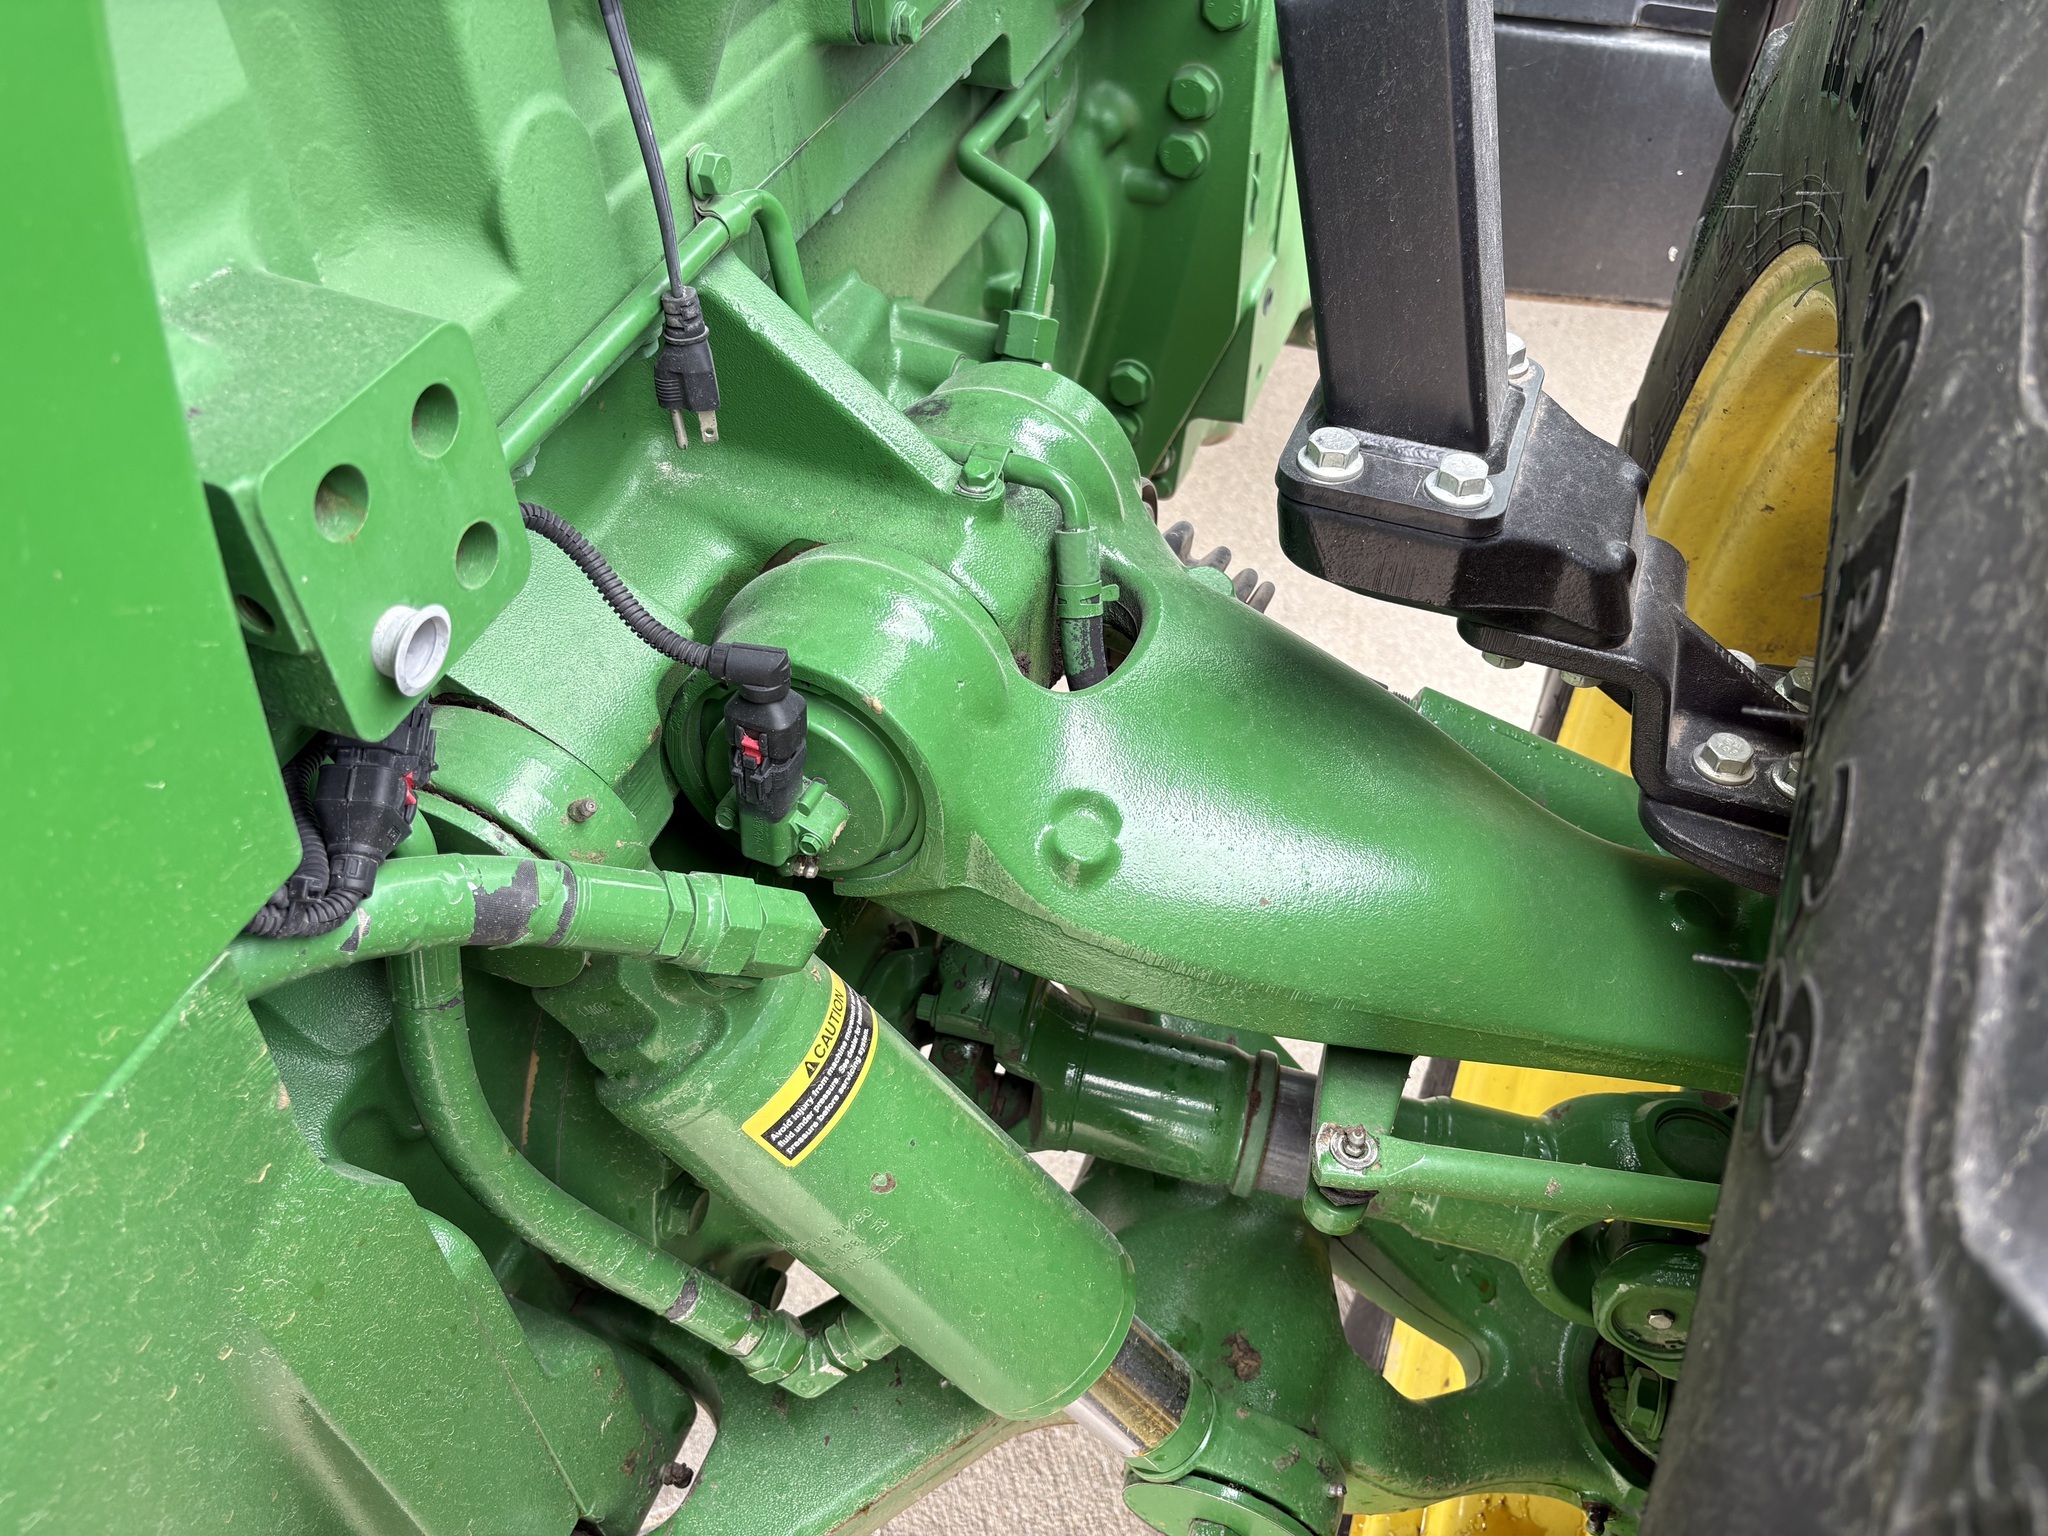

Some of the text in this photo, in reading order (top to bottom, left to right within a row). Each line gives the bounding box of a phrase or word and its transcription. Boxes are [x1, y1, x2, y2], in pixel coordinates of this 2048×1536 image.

[770, 1120, 794, 1141] Avoid
[791, 1095, 815, 1121] injury
[811, 1075, 829, 1097] from
[826, 1041, 848, 1077] machine
[844, 1003, 856, 1041] movement
[777, 1130, 796, 1148] fluid
[793, 1110, 815, 1133] under
[813, 1077, 841, 1113] pressure.
[838, 1058, 850, 1074] See
[847, 1035, 859, 1059] dealer
[854, 1024, 862, 1037] for
[814, 989, 845, 1059] CAUTION
[786, 1028, 870, 1155] pressure before servicing system.
